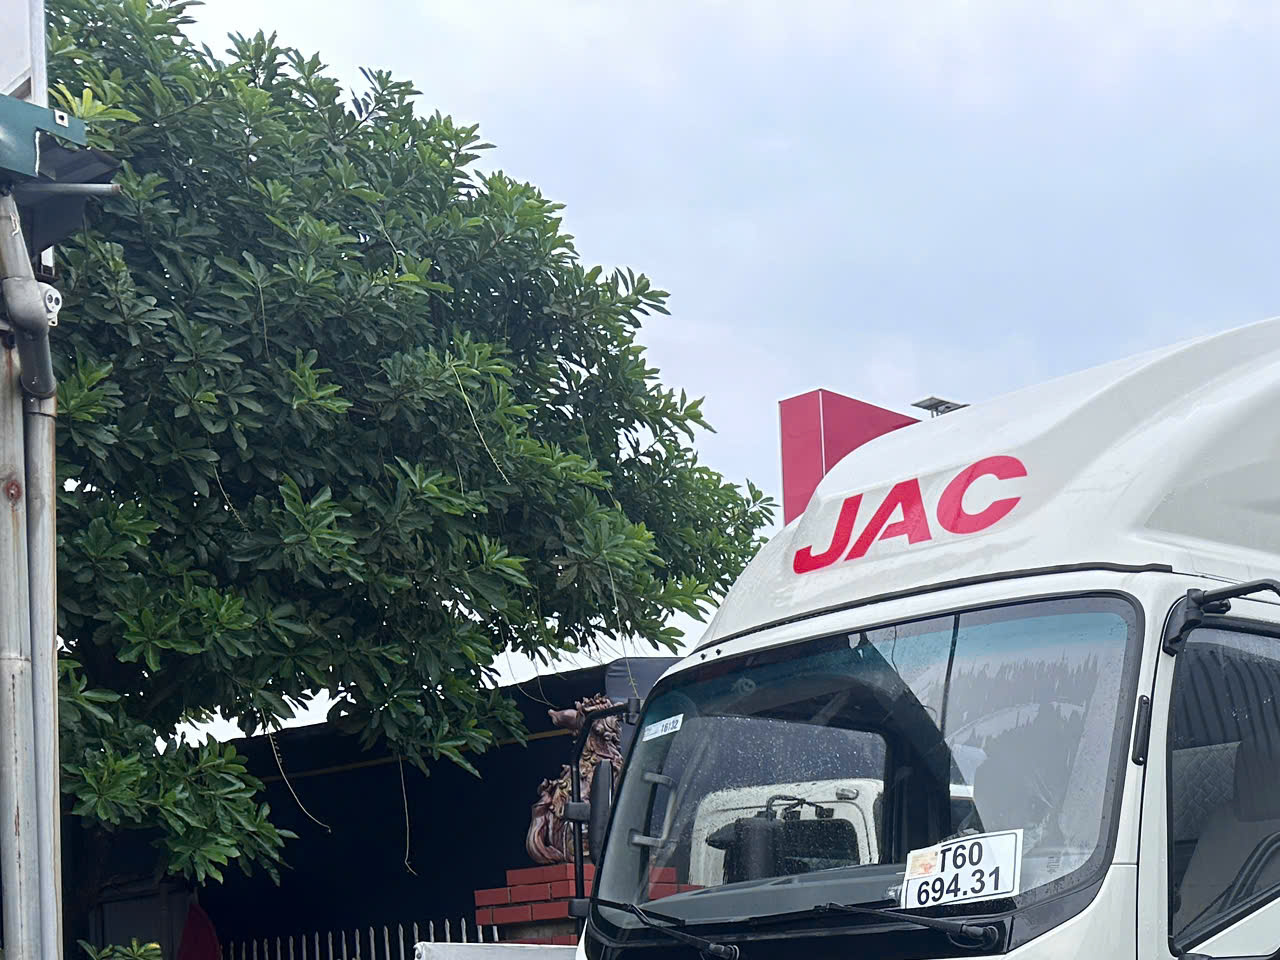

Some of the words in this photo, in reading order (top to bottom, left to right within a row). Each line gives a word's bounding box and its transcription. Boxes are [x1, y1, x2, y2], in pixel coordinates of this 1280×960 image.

[793, 455, 1028, 575] JAC
[941, 841, 983, 873] T60
[917, 866, 1000, 905] 694.31
